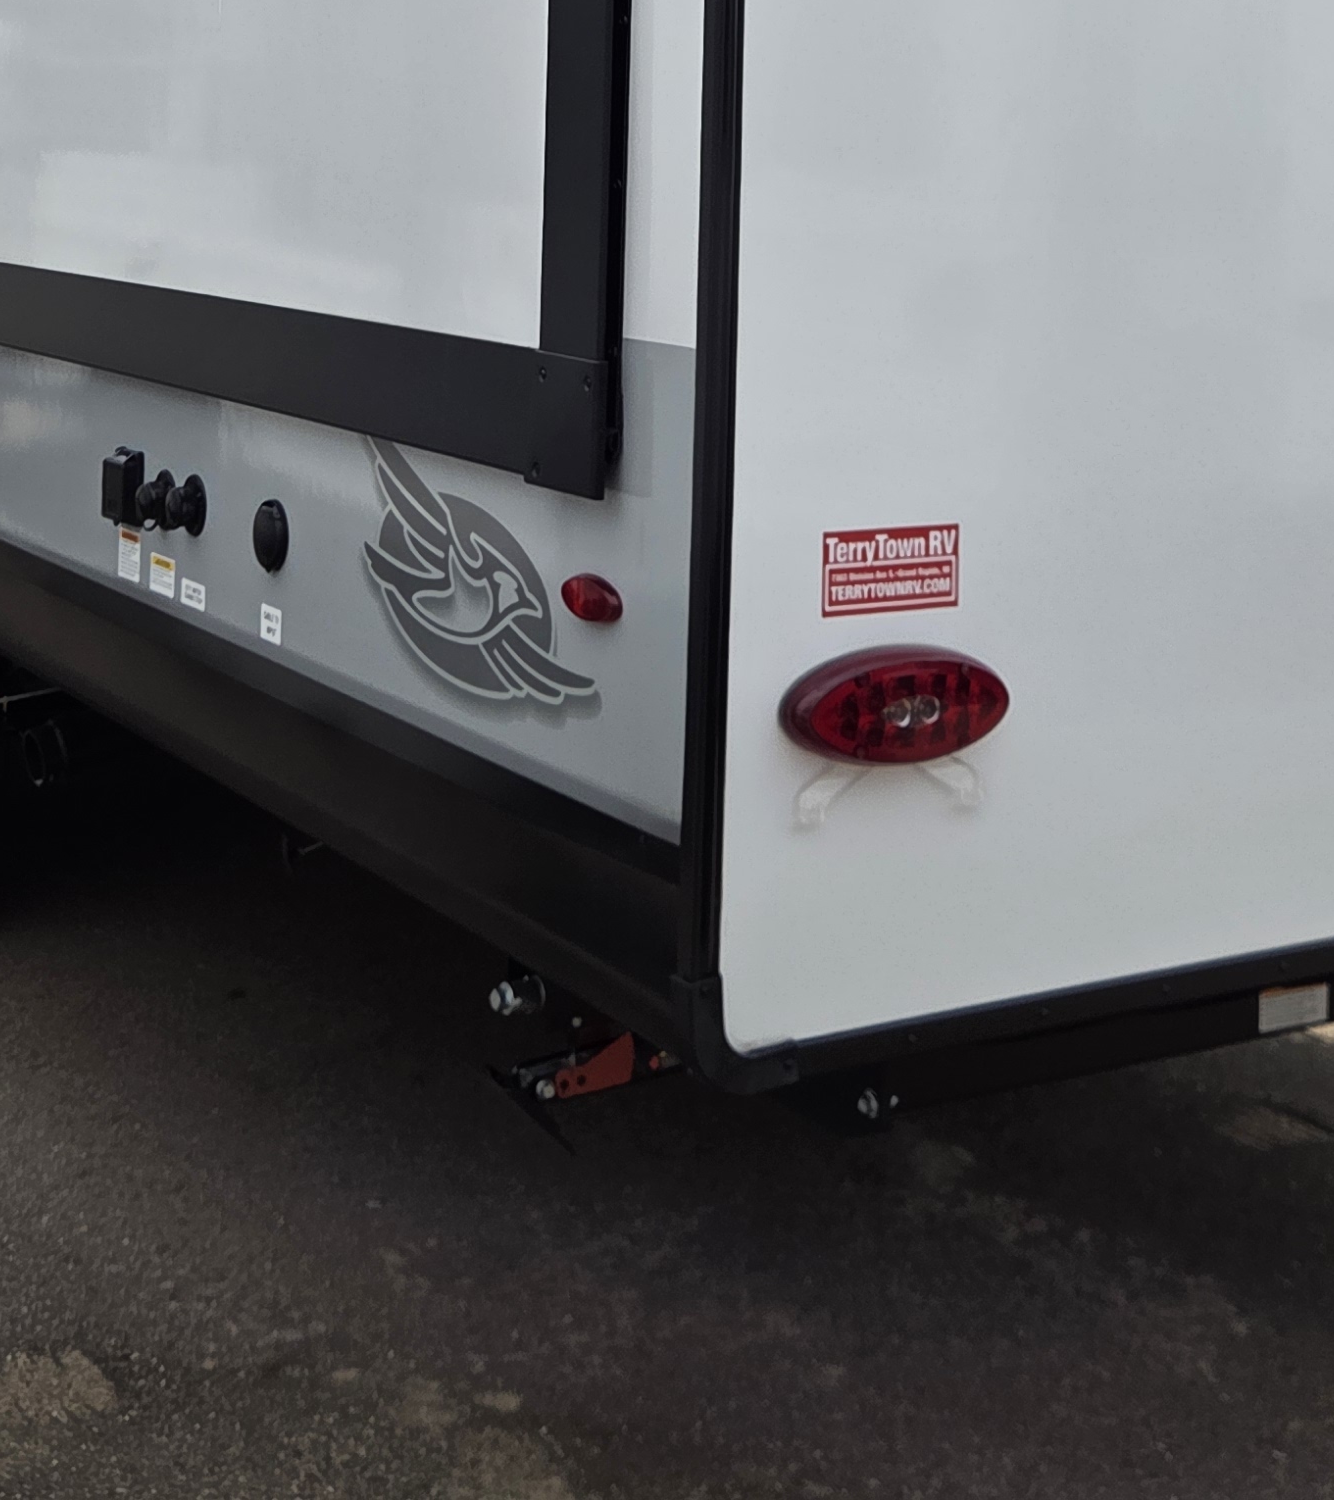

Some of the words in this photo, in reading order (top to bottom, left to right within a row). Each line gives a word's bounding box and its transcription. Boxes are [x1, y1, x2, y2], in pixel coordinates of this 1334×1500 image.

[826, 533, 926, 567] TerryTown
[928, 528, 956, 556] RV
[830, 576, 951, 602] TERRYTOWNRV.COM
